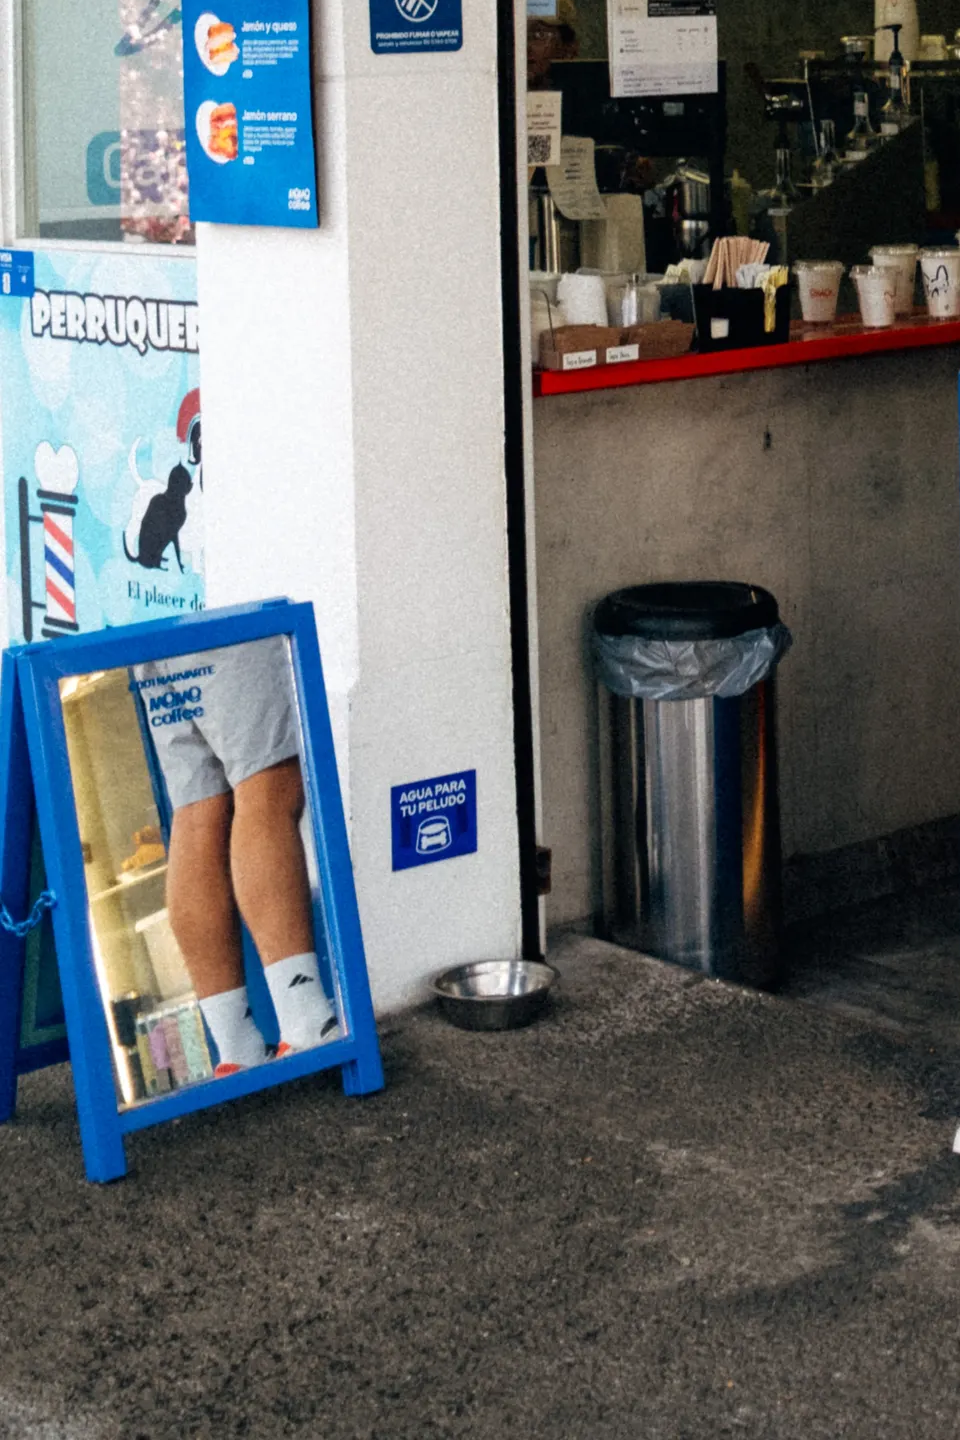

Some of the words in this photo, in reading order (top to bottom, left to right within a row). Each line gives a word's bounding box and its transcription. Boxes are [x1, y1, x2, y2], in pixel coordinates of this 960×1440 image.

[241, 20, 265, 33] Jamón
[265, 23, 271, 35] y
[242, 109, 266, 122] Jamón
[267, 111, 297, 122] serrano
[127, 580, 140, 600] El
[145, 585, 186, 608] placer
[151, 706, 205, 727] coffee
[399, 787, 433, 805] AGUA
[434, 779, 467, 797] PARA
[400, 804, 416, 818] TU
[418, 793, 466, 814] PELUDO
